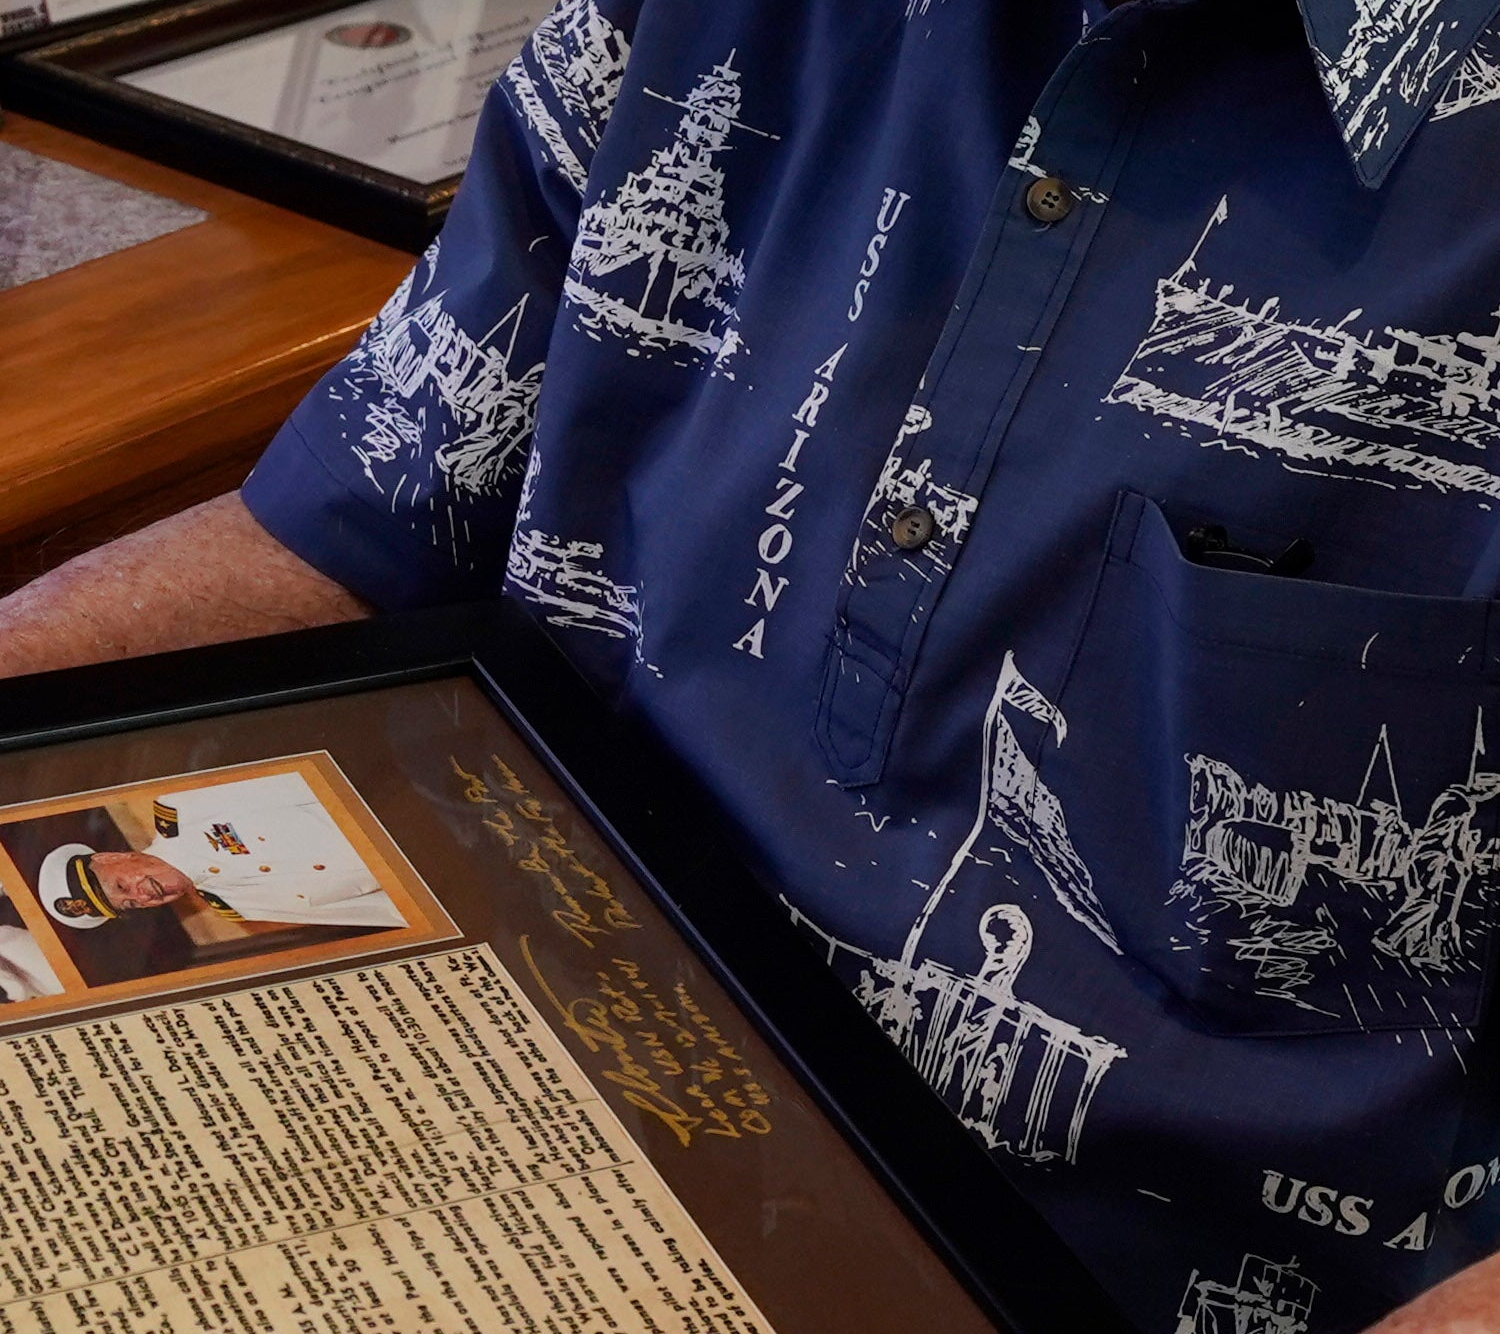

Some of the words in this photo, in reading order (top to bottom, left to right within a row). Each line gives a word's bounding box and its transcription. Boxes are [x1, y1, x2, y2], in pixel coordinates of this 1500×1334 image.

[846, 185, 911, 325] USS
[731, 341, 848, 662] ARIZONA
[459, 973, 474, 987] Ft.
[469, 988, 484, 999] at
[479, 1001, 504, 1026] down
[497, 1028, 520, 1049] shot
[515, 1050, 534, 1070] was
[530, 1071, 562, 1103] planes
[576, 1133, 596, 1156] One
[1261, 1167, 1376, 1238] USS
[292, 1302, 306, 1315] A.
